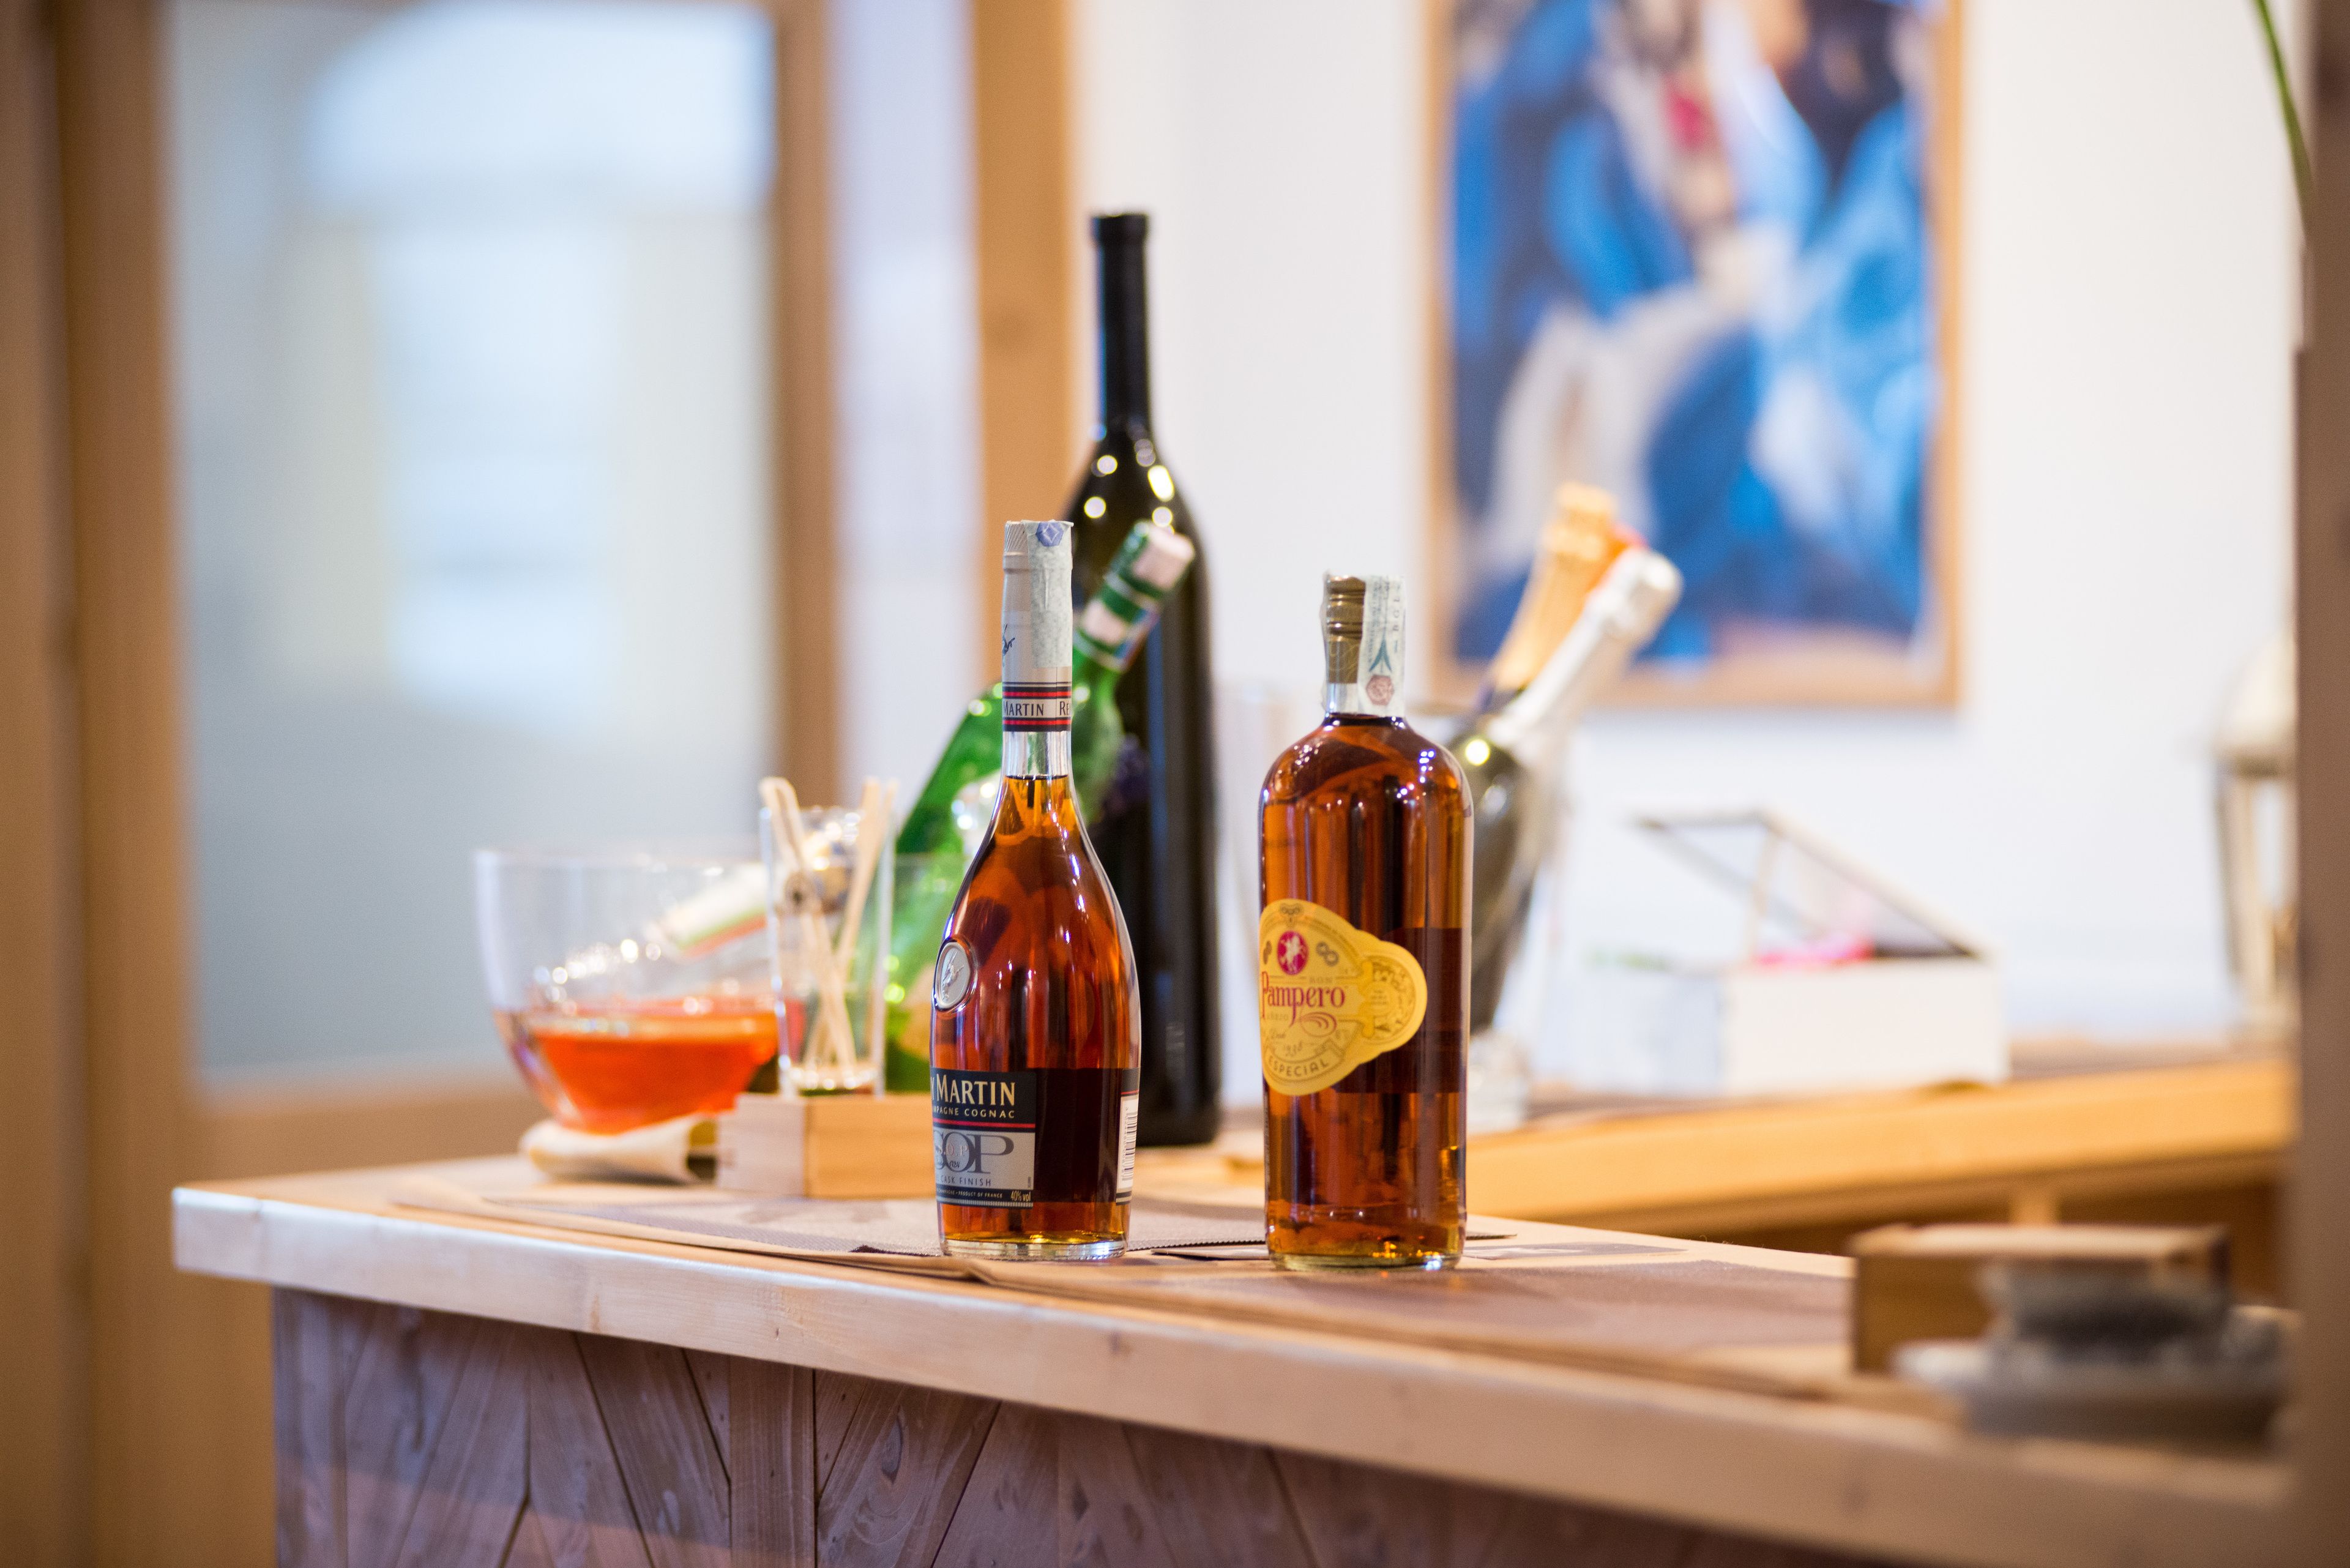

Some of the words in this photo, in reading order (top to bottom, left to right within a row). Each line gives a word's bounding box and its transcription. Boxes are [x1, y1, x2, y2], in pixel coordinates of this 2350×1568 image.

[1004, 701, 1044, 716] MARTIN
[1262, 971, 1346, 1028] Pampero
[1269, 1055, 1329, 1077] ESPECIAL
[936, 1073, 1016, 1106] MARTIN
[964, 1108, 1015, 1118] COGNAC
[941, 1174, 955, 1184] CASK
[960, 1176, 991, 1187] FINISH
[1010, 1190, 1021, 1201] 40%
[1022, 1191, 1031, 1201] vol
